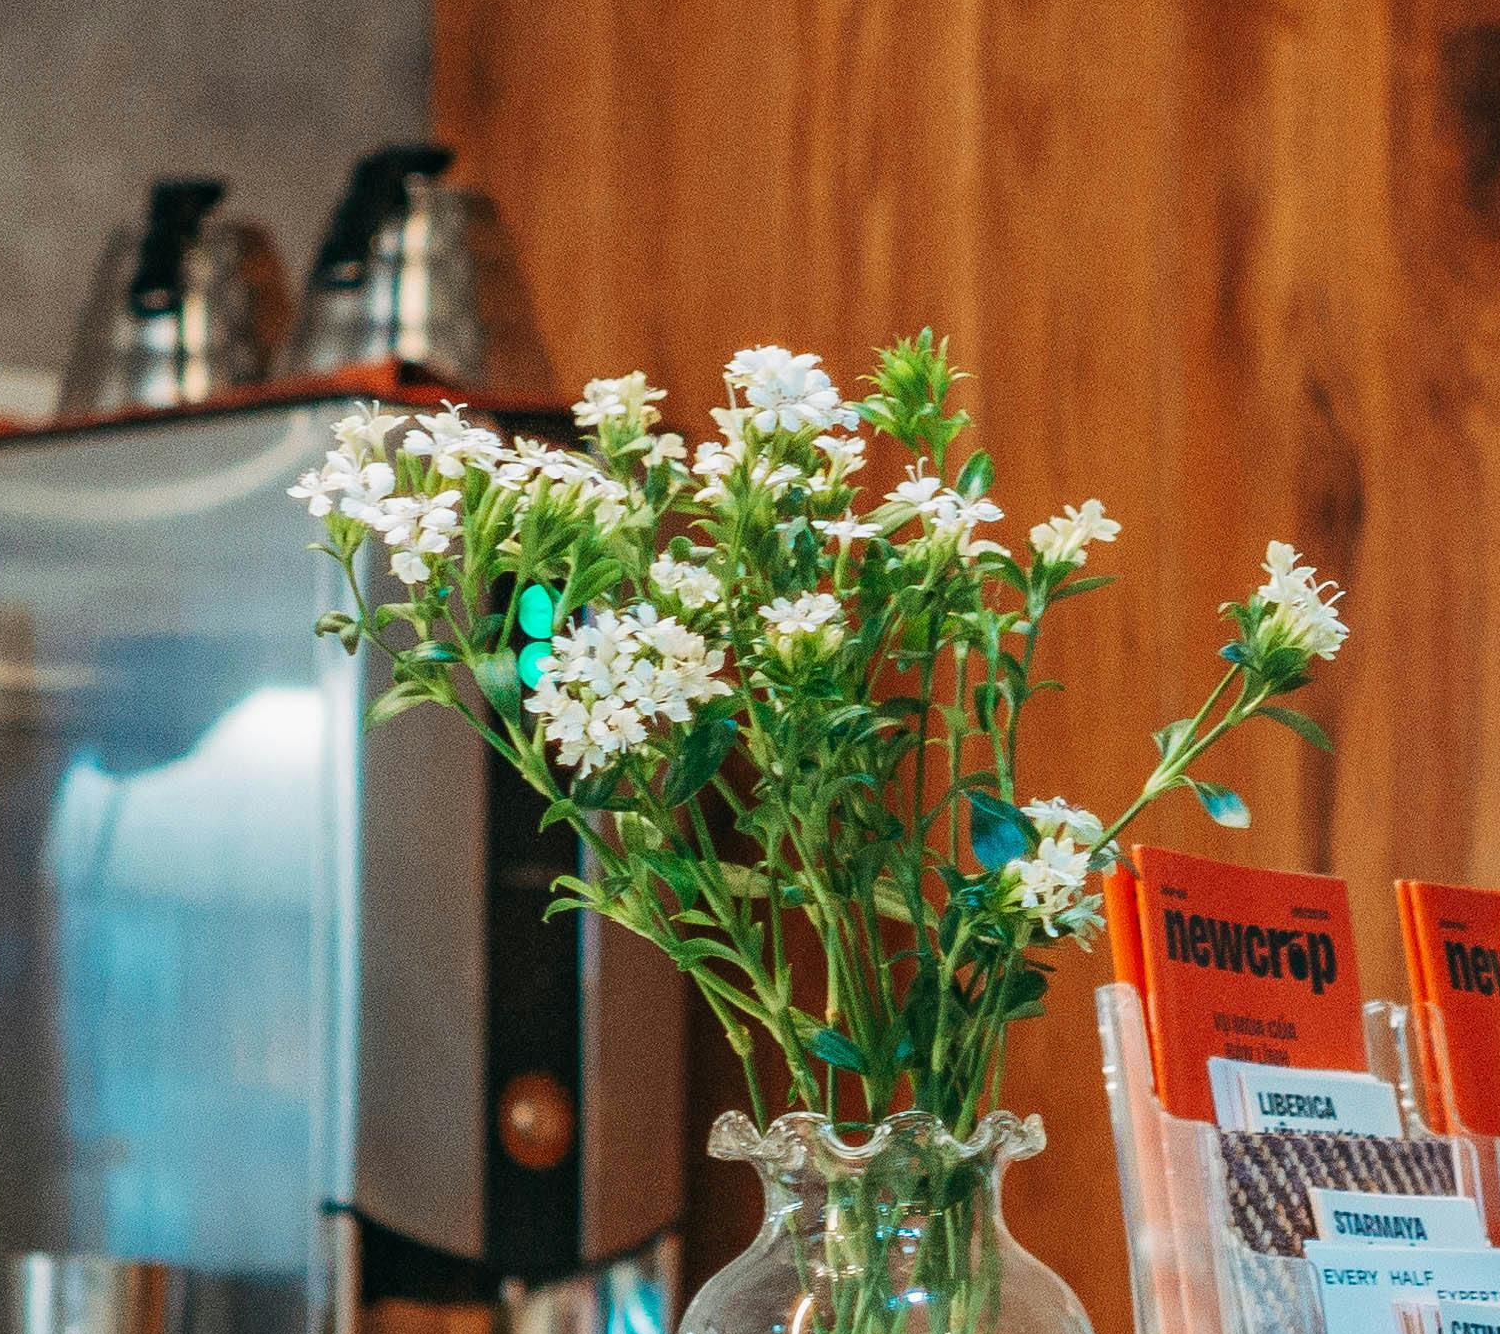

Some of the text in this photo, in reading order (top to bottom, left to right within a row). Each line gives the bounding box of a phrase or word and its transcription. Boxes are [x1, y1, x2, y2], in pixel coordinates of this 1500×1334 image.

[1164, 908, 1337, 995] newcrop
[1258, 1092, 1337, 1120] LIBERICA
[1333, 1210, 1428, 1241] STARMAYA
[1324, 1269, 1434, 1287] EVERY HALF
